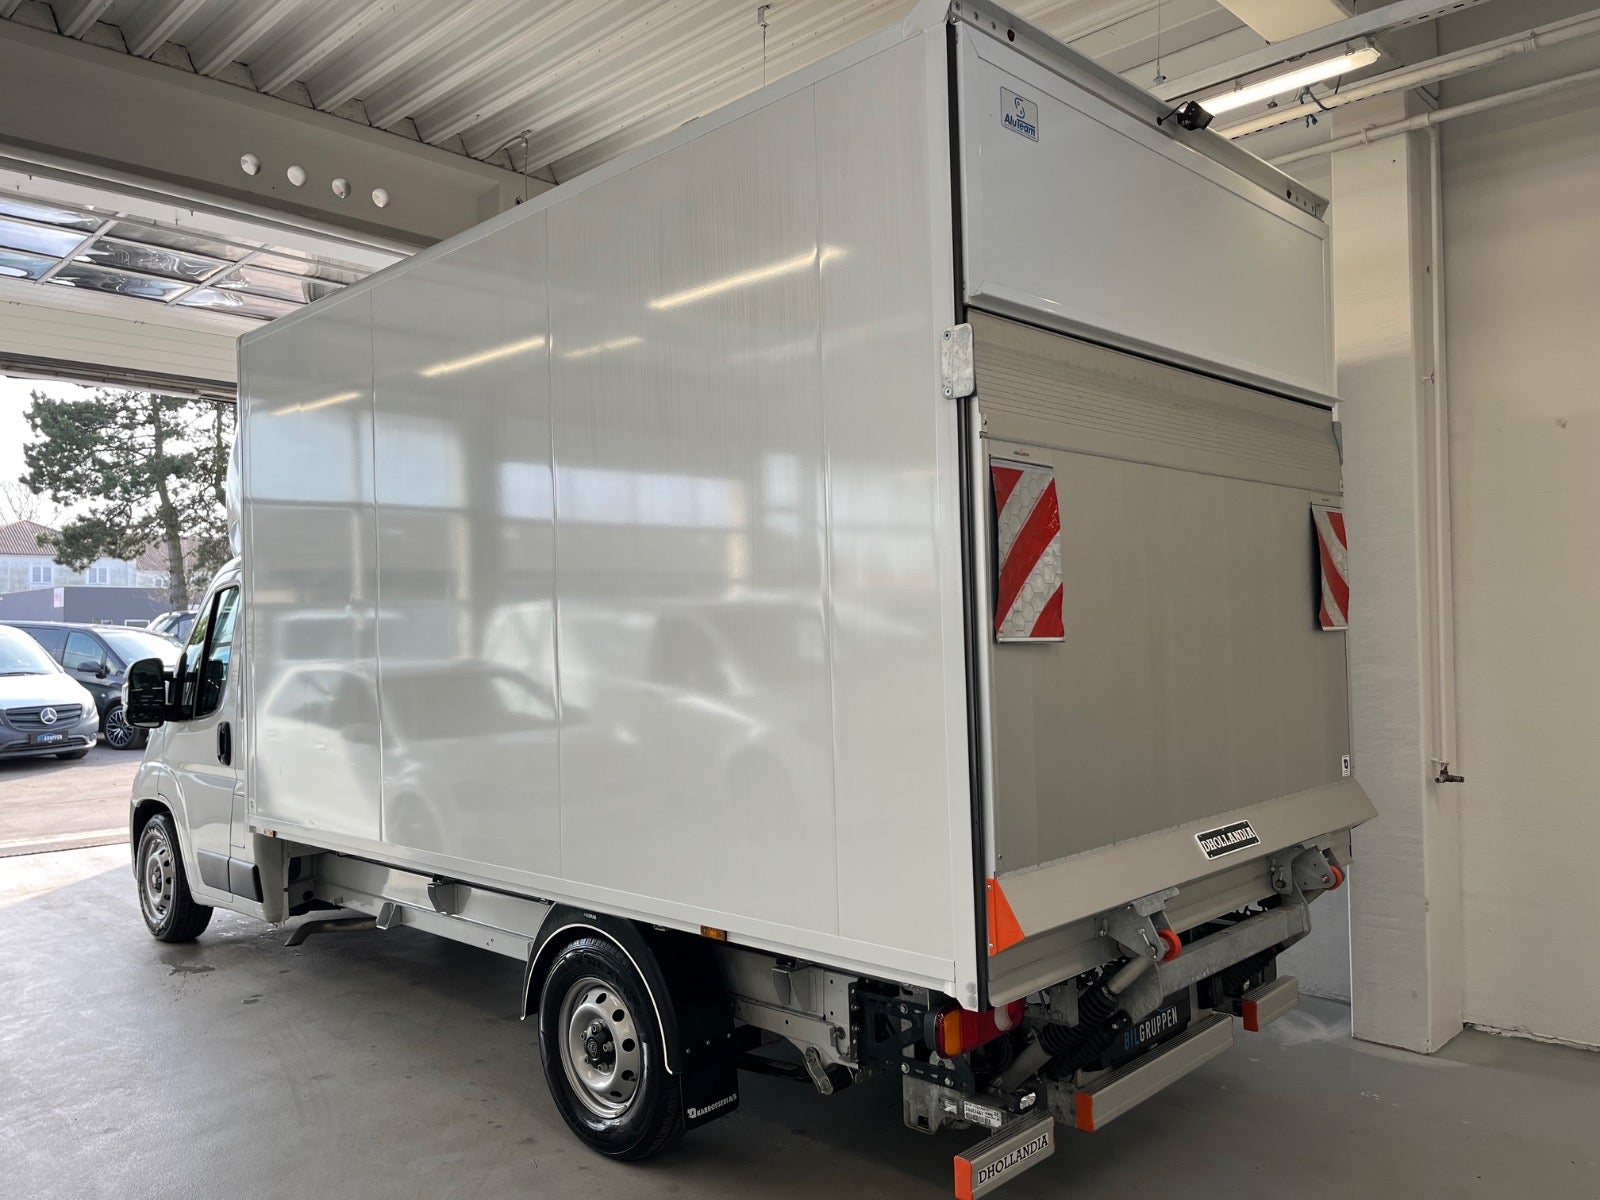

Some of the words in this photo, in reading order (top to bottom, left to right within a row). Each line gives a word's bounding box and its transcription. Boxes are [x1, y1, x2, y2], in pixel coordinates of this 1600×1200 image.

[1004, 113, 1036, 137] AluTeam
[1201, 827, 1256, 852] DHOLLANDIA
[1124, 1006, 1178, 1050] BILGRUPPEN
[978, 1135, 1048, 1184] DHOLLANDIA
